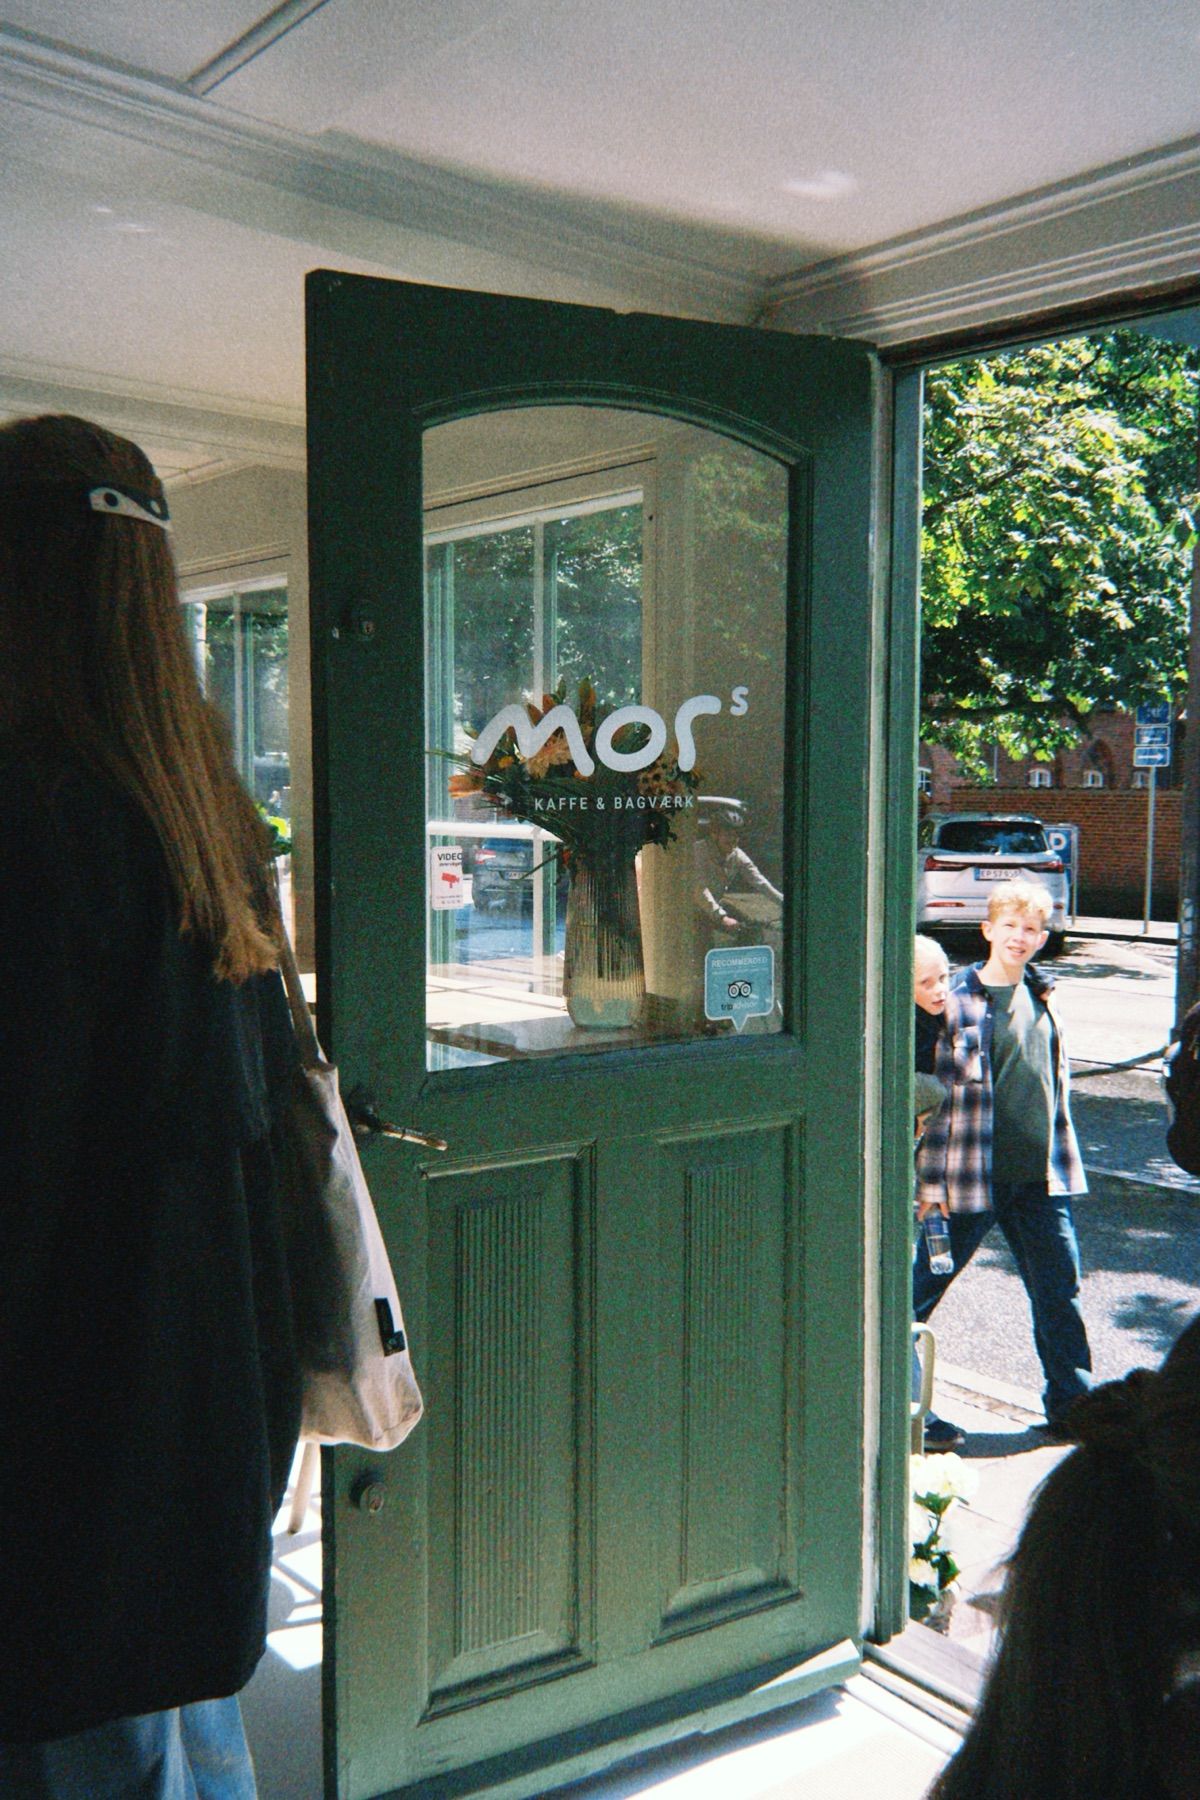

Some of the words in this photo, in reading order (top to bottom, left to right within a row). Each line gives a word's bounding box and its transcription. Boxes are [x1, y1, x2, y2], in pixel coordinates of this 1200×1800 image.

[534, 797, 588, 811] KAFFE
[596, 797, 605, 810] &
[614, 795, 694, 810] BAGVÆRK
[437, 852, 464, 861] VIDEO
